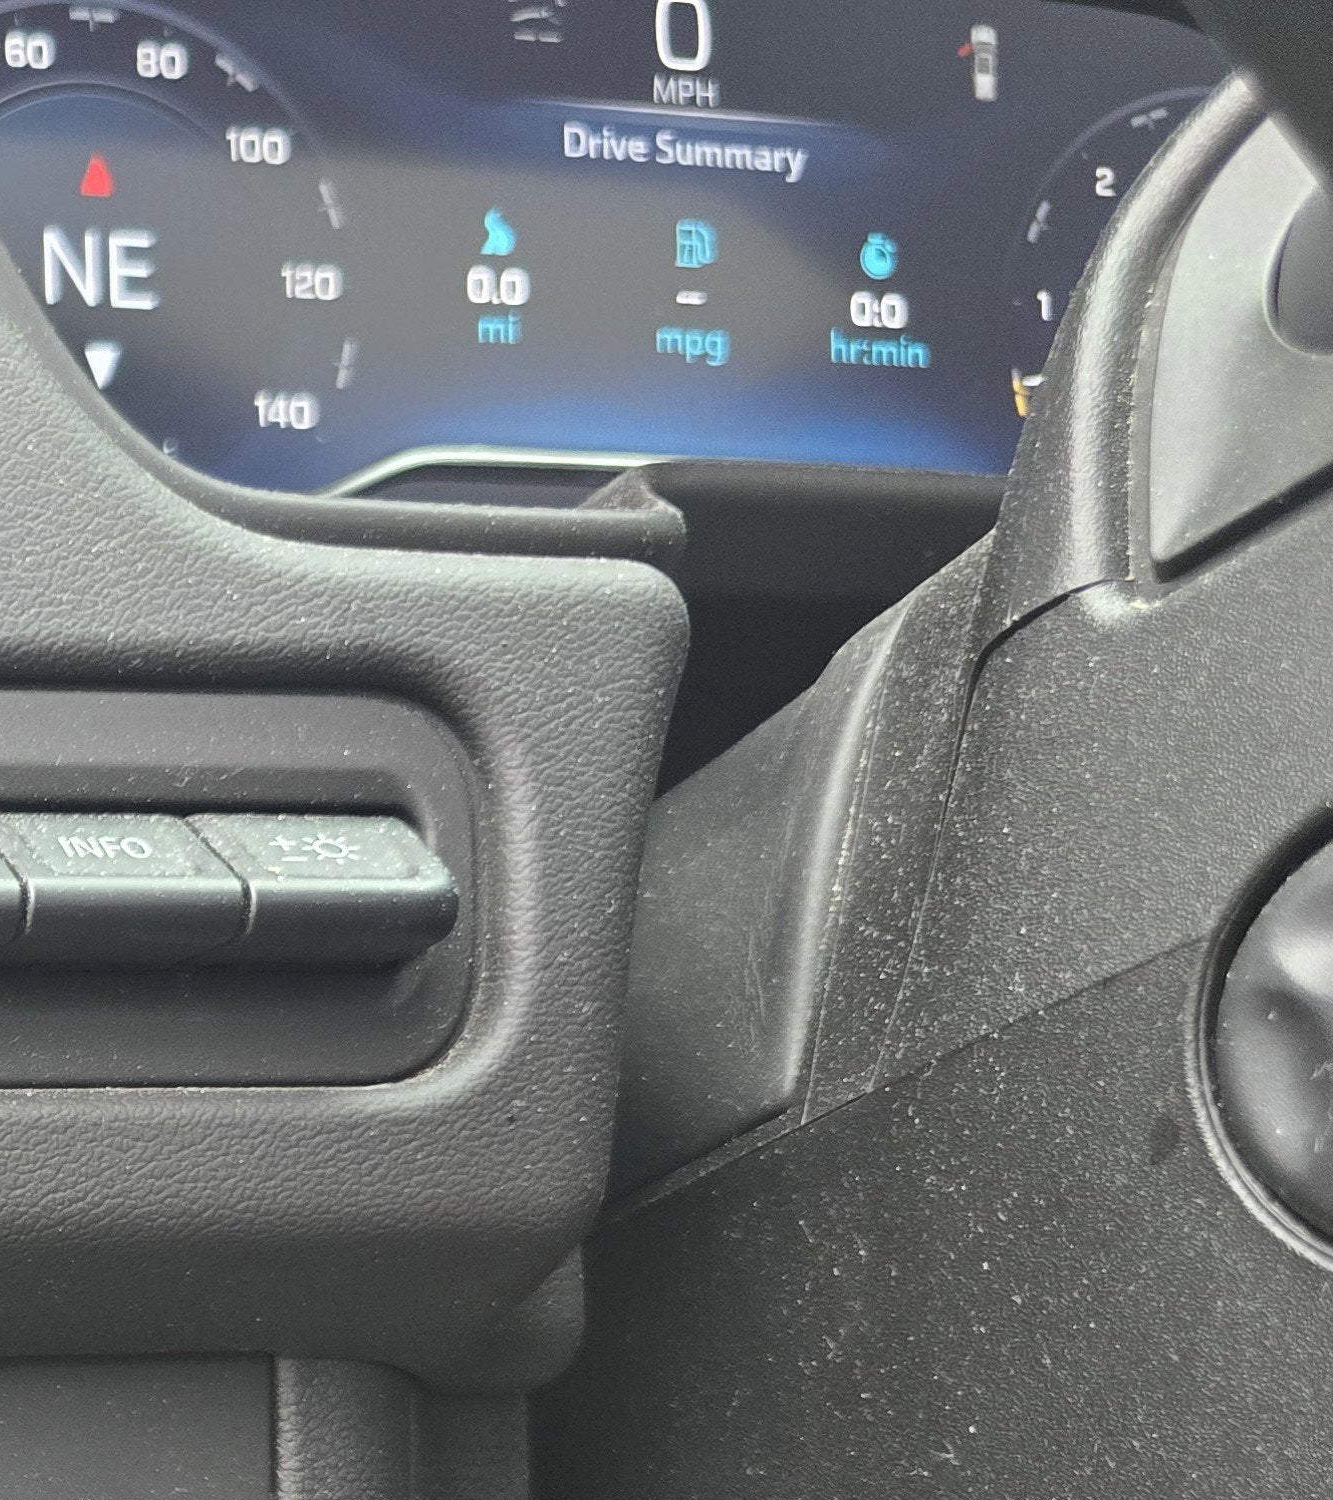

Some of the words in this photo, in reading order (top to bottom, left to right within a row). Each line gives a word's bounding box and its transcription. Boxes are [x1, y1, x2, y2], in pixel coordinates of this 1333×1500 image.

[4, 33, 55, 70] 60
[654, 0, 713, 70] 0
[136, 41, 188, 79] 80
[652, 76, 720, 106] MPH
[226, 126, 290, 165] 100
[563, 123, 648, 161] Drive
[654, 132, 808, 182] Summary
[1094, 167, 1116, 197] 2
[42, 227, 160, 310] NE
[281, 262, 343, 300] 120
[467, 266, 530, 305] 0.0
[478, 312, 520, 344] mi
[850, 291, 908, 328] 0:0
[656, 325, 729, 366] mpg
[830, 329, 930, 368] hr:min
[254, 390, 318, 430] 140
[58, 836, 153, 860] INFO
